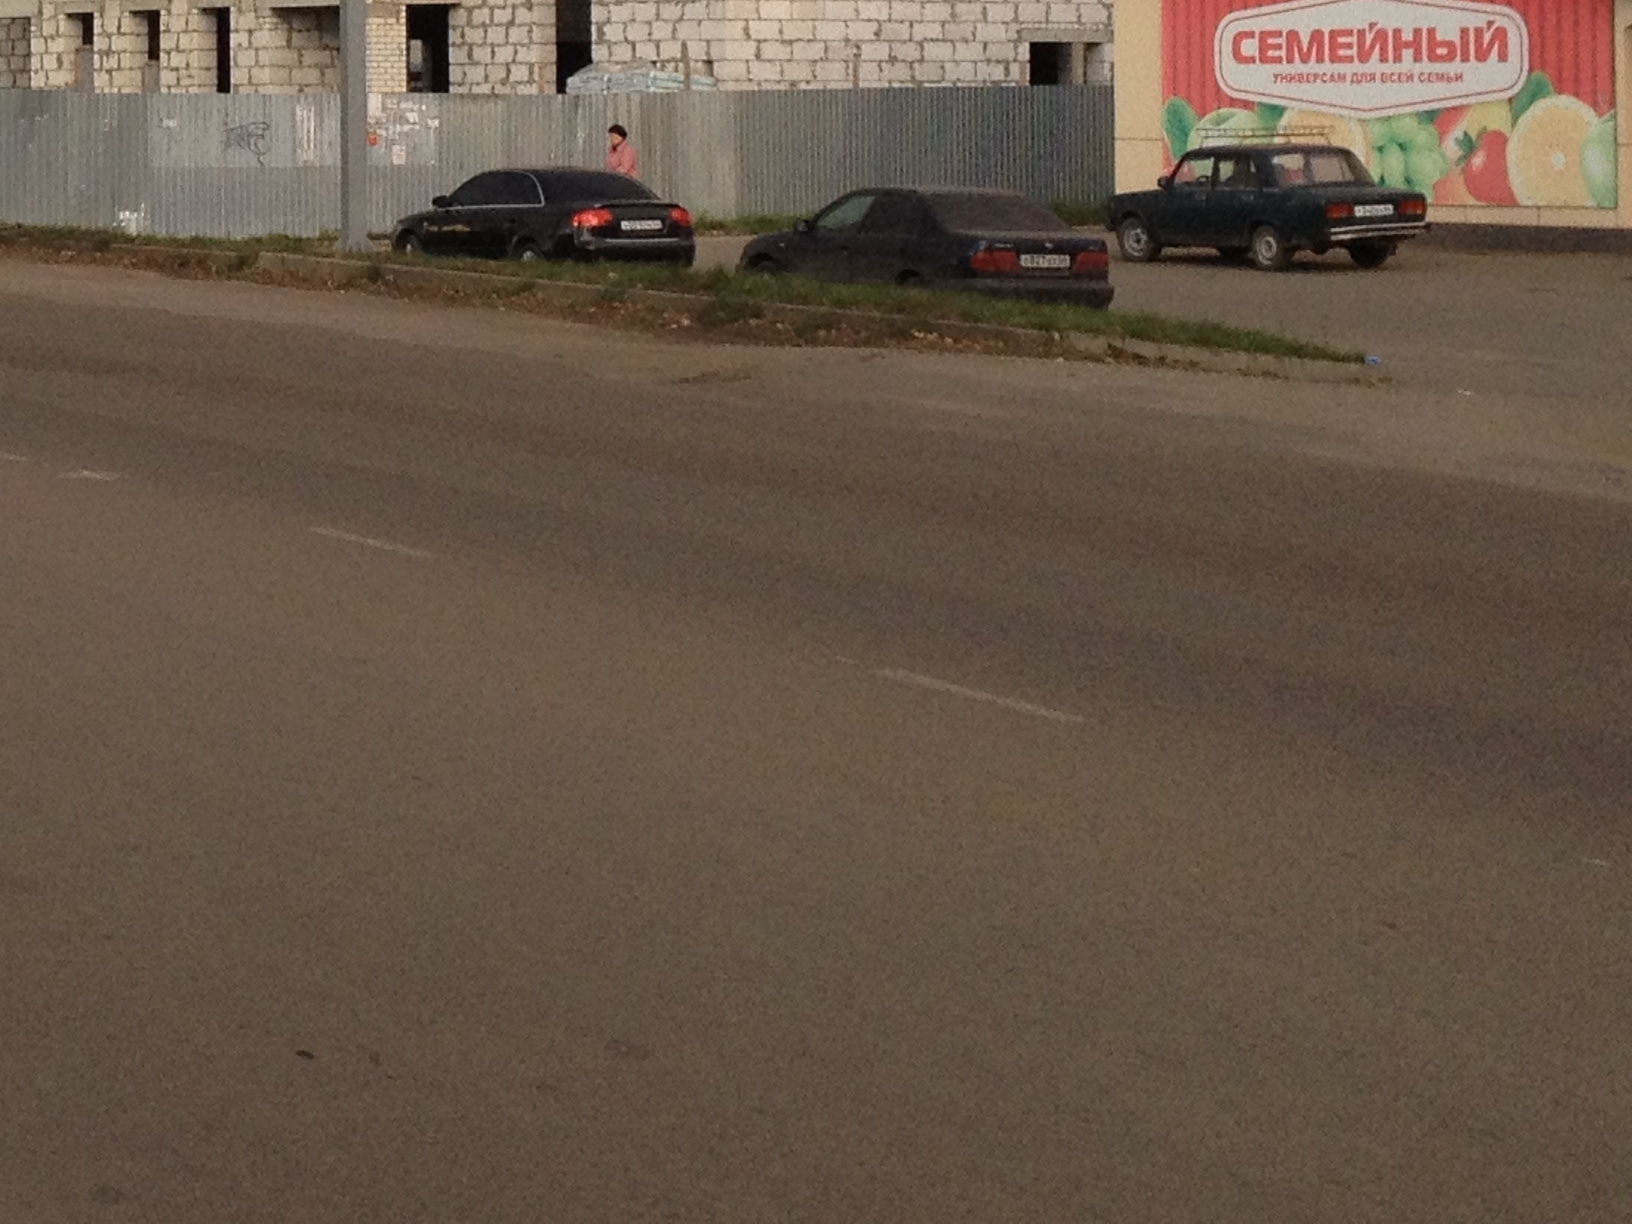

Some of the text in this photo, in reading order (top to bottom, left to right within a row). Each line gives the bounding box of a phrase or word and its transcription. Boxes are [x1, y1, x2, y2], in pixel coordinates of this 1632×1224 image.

[1232, 20, 1509, 64] СЕМЕЙНЫЙ
[1272, 70, 1464, 86] УНИВЕРСАМ ДЛЯ ВСЕЙ СЕМЬИ
